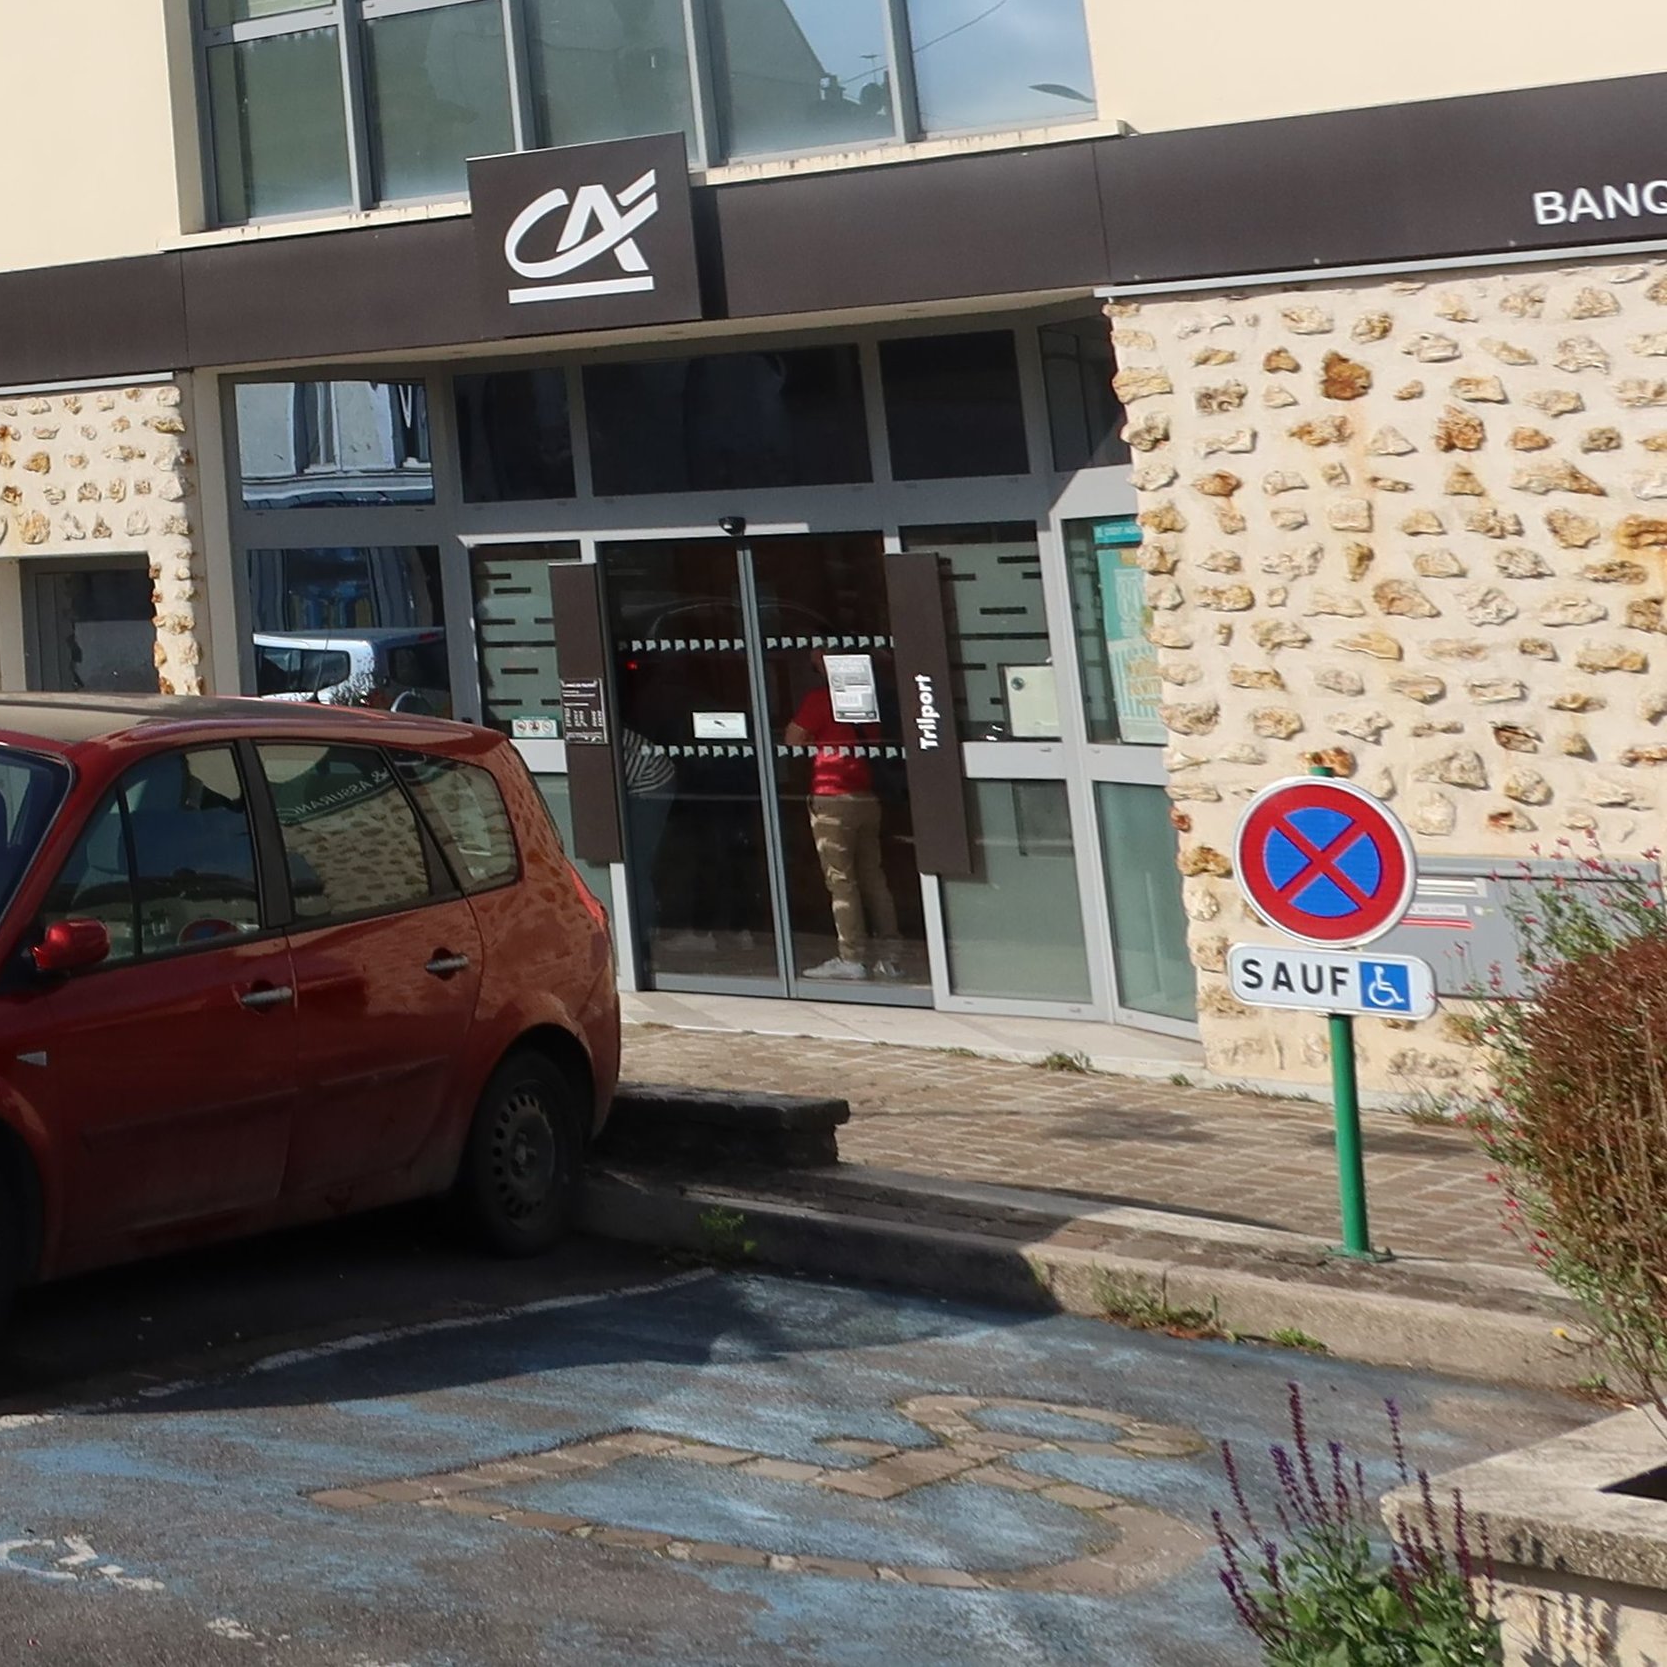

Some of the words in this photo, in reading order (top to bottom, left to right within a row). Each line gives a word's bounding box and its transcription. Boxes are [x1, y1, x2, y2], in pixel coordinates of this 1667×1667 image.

[504, 168, 659, 279] CA
[914, 673, 941, 751] Trilport
[1240, 958, 1351, 997] SAUF
